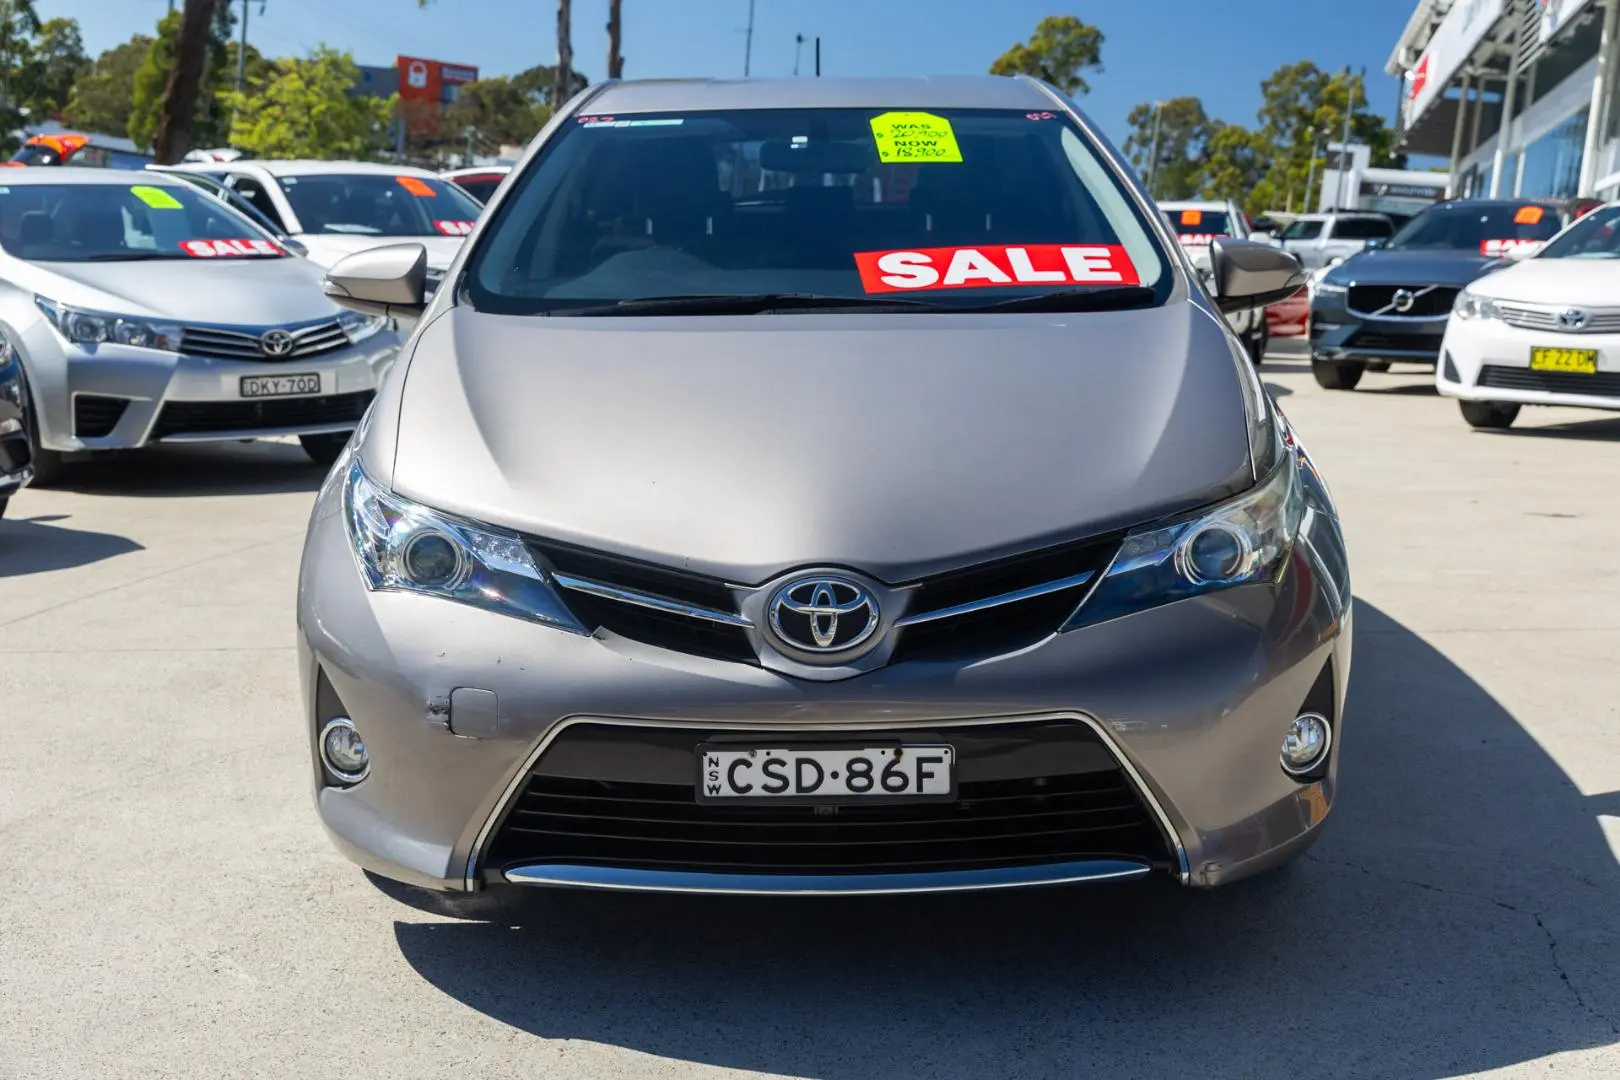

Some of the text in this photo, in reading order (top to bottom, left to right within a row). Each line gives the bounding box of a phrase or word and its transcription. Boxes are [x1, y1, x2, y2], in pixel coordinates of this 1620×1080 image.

[440, 220, 475, 235] SA
[186, 239, 280, 257] SALE
[877, 246, 1122, 289] SALE
[706, 756, 722, 796] NSW
